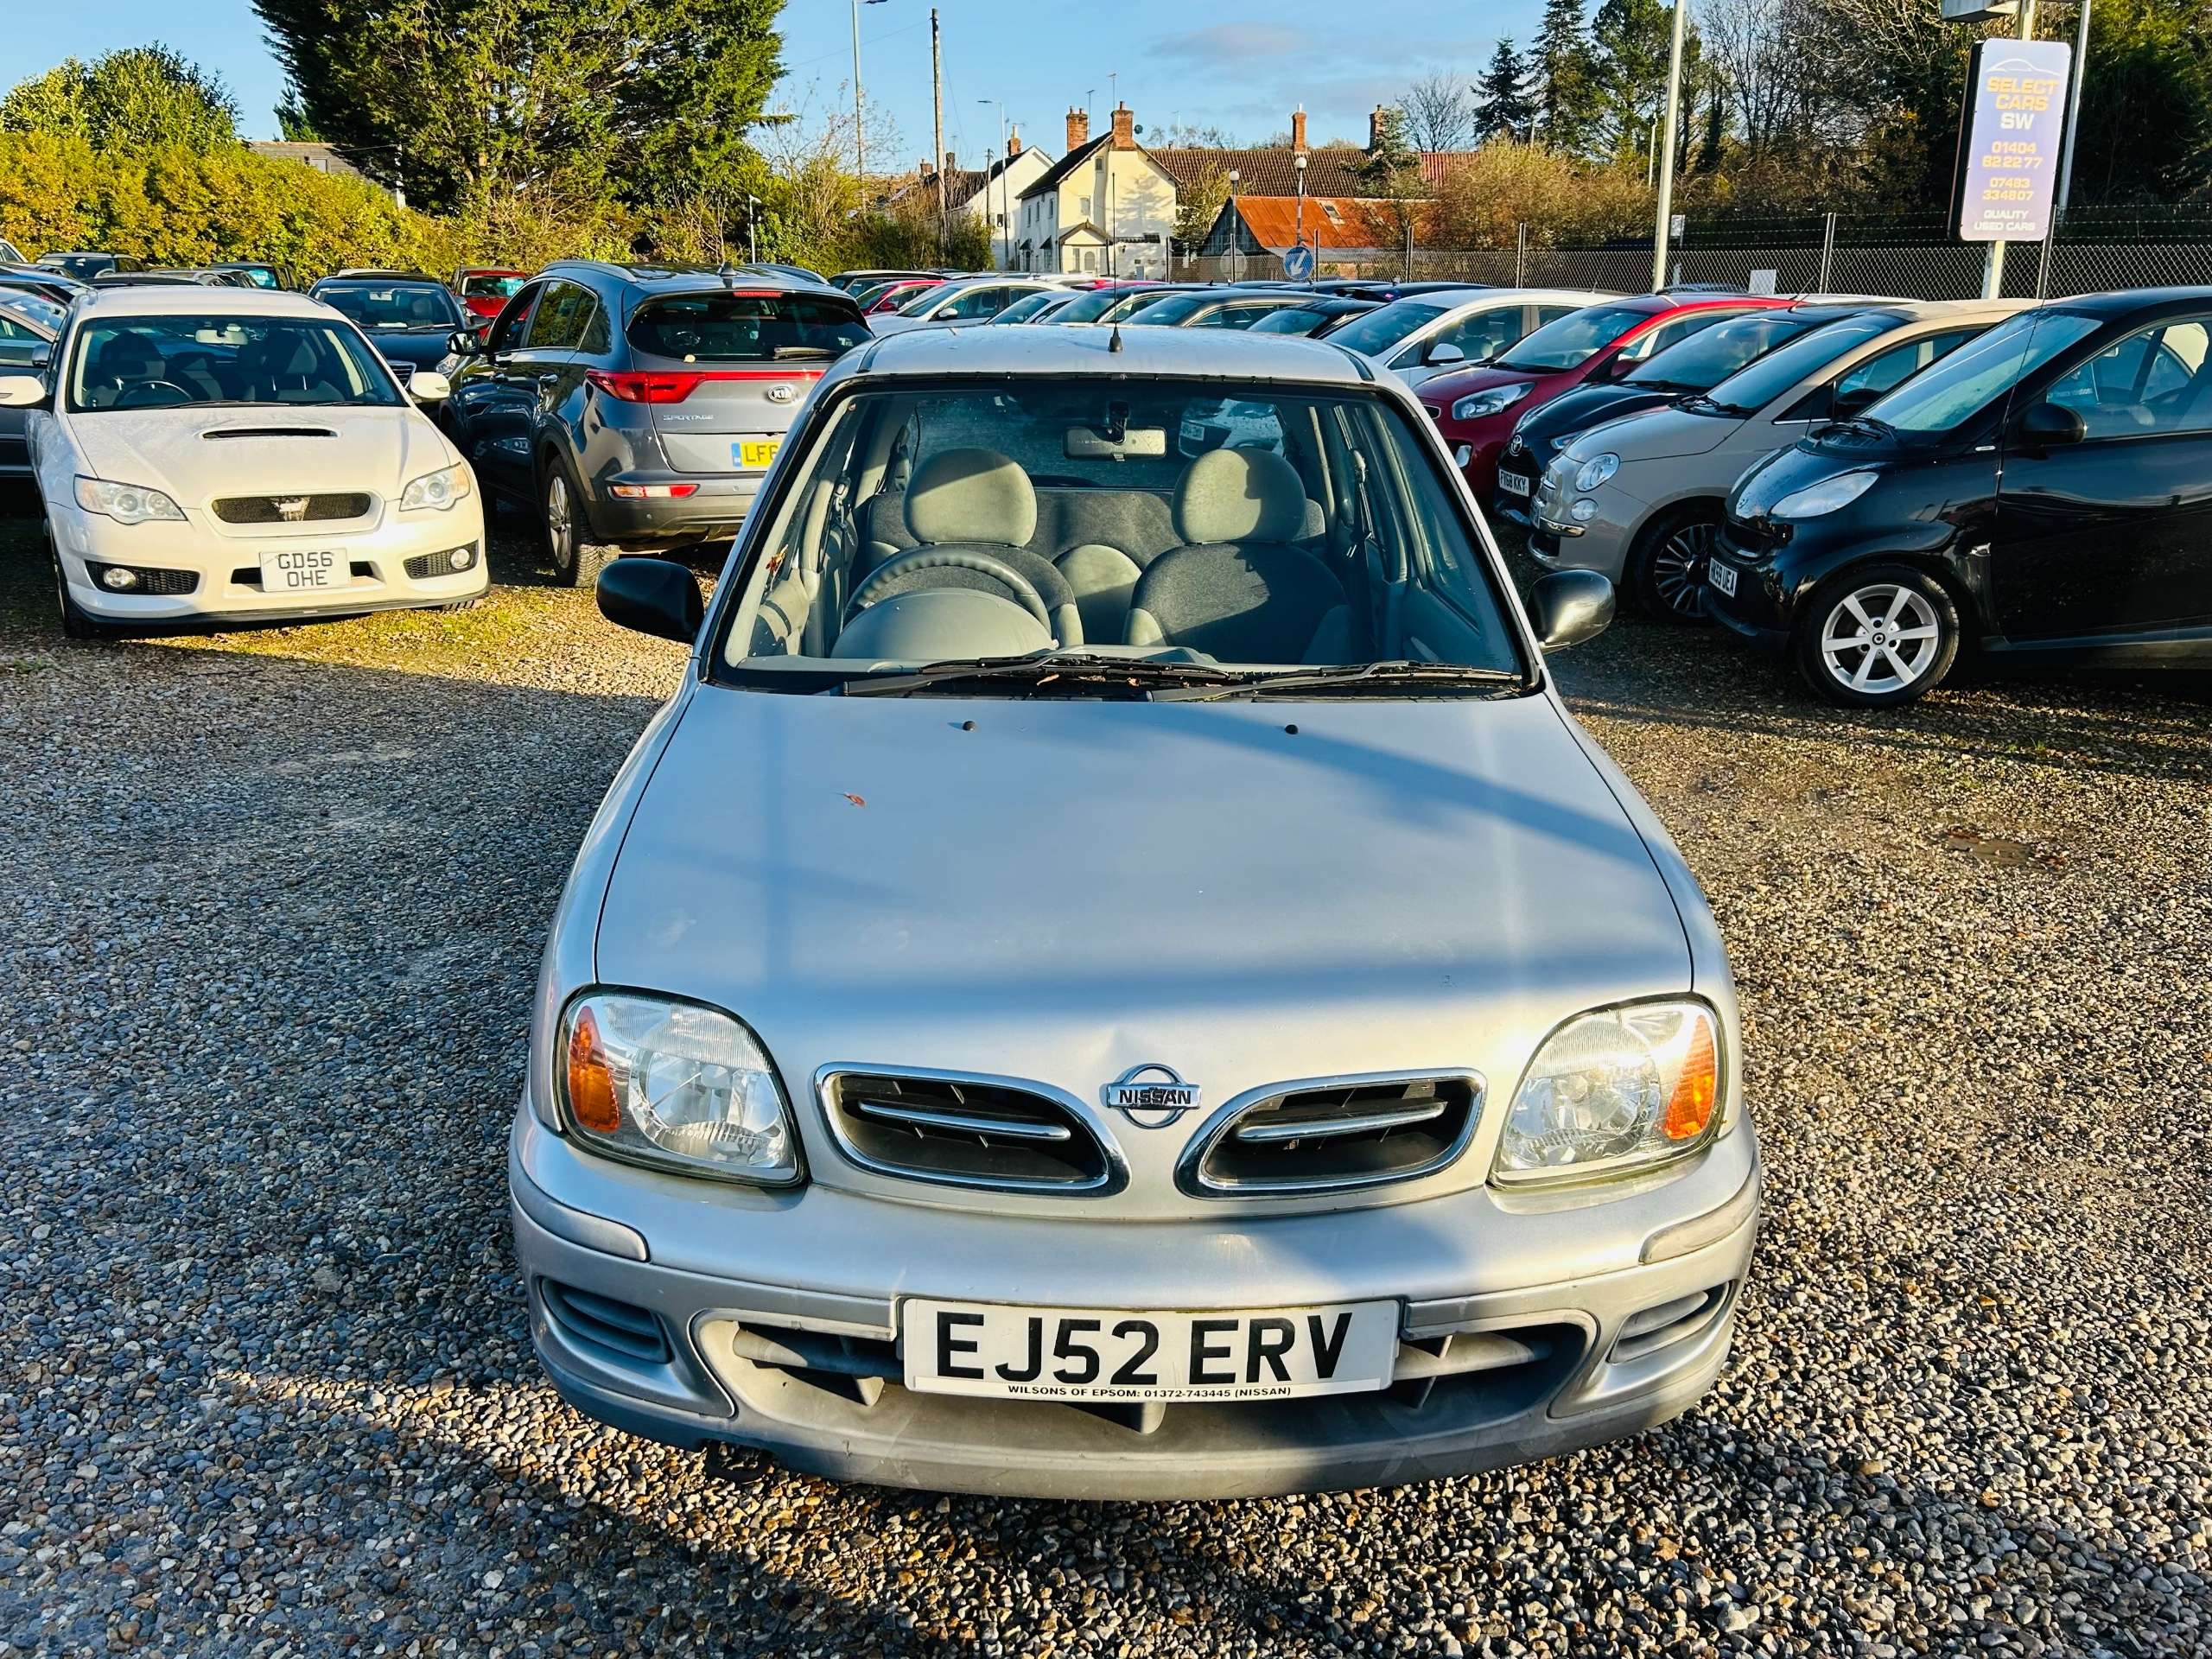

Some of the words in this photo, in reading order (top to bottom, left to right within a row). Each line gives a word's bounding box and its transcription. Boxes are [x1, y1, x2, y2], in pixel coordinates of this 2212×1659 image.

[1986, 76, 2060, 93] SELECT
[1996, 94, 2049, 111] CARS
[2000, 112, 2034, 130] SW
[1992, 141, 2037, 154] 01404
[1984, 209, 2029, 219] QUALITY
[1974, 222, 2003, 232] USED
[2005, 222, 2036, 232] CARS
[772, 389, 792, 399] KIA
[277, 551, 333, 569] GD56
[287, 569, 327, 587] OHE
[1119, 1089, 1192, 1104] NISSAN
[937, 1311, 1160, 1386] EJ52
[1189, 1312, 1353, 1385] ERV
[1008, 1385, 1066, 1395] WILSONS
[1092, 1389, 1141, 1397] EPSOM:
[1144, 1389, 1231, 1398] 01372-743445
[1234, 1387, 1292, 1398] (NISSAN)
